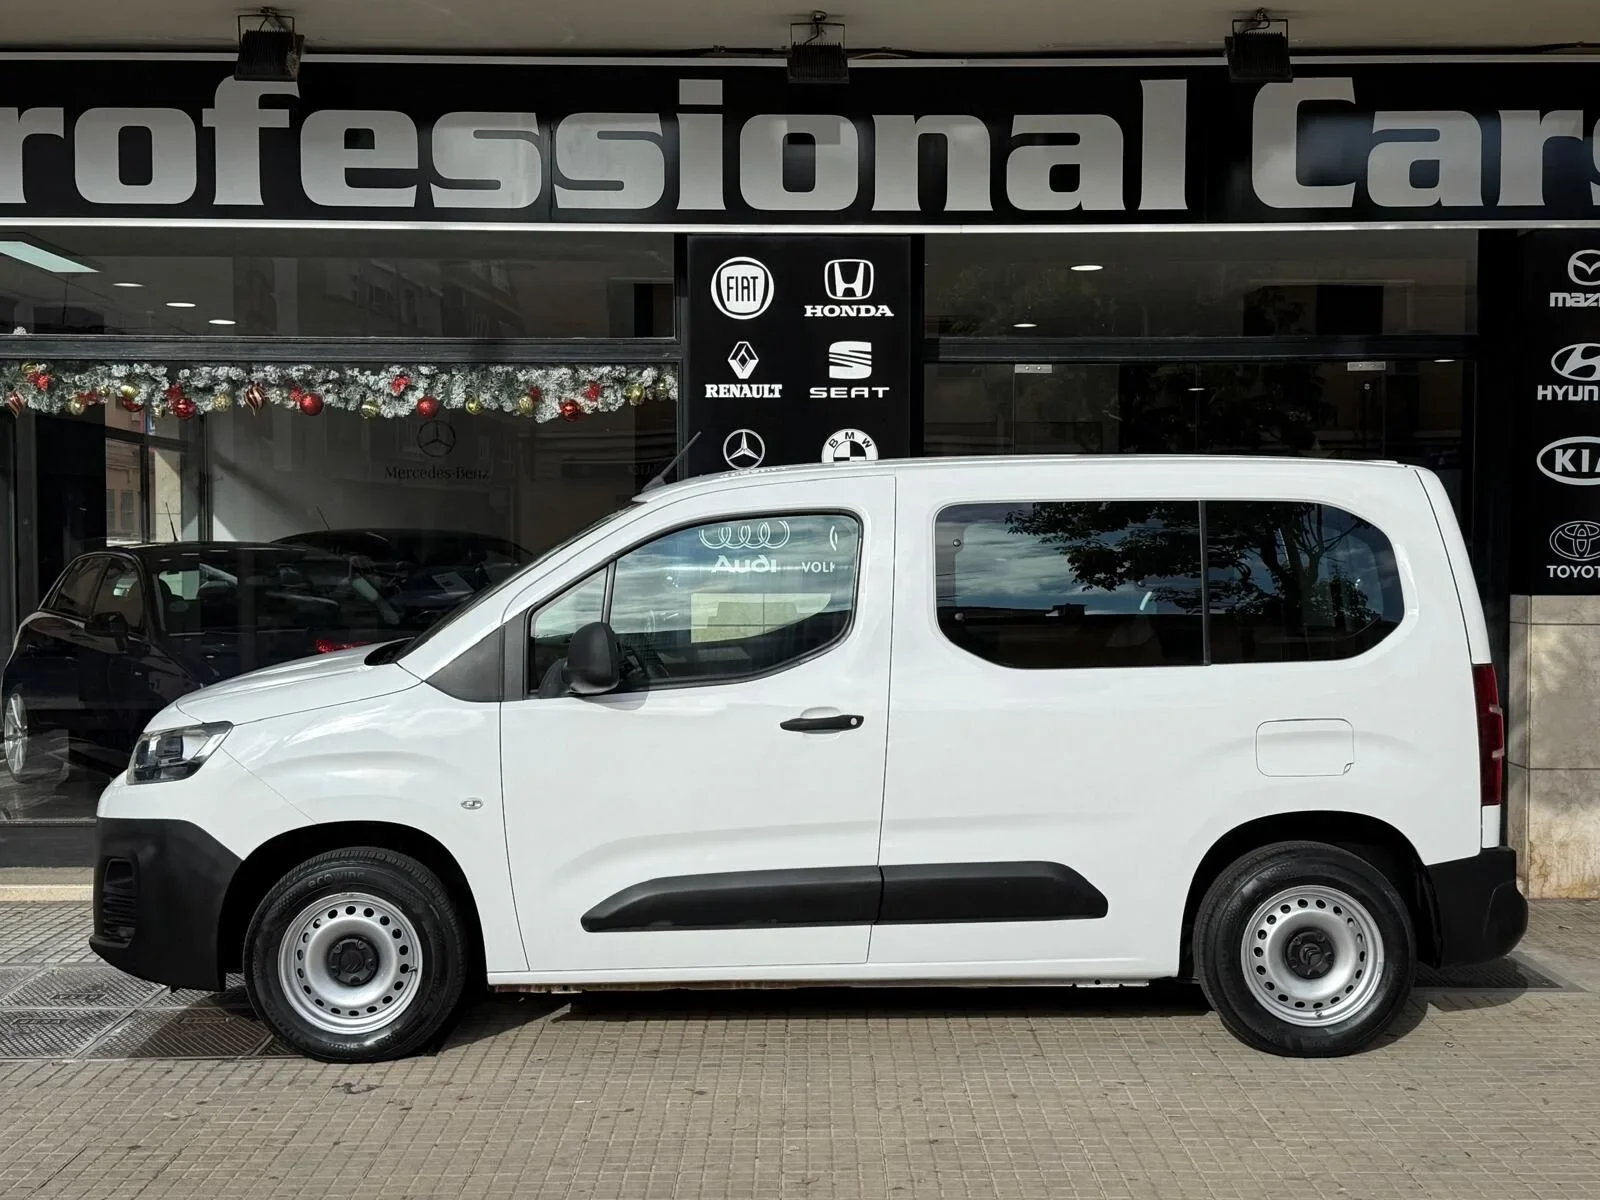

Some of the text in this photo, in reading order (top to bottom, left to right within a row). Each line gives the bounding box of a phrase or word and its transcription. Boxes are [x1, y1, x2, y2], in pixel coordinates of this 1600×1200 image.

[1252, 76, 1600, 209] Car
[726, 276, 759, 302] FIAT
[1549, 292, 1600, 307] maz
[804, 304, 895, 317] HONDA
[704, 383, 783, 399] RENAULT
[809, 386, 890, 399] SEAT
[1537, 384, 1599, 401] HYUN
[828, 431, 873, 449] BMW
[1554, 448, 1600, 473] KI
[384, 464, 490, 480] Mercedes-Benz
[711, 554, 777, 574] Audi
